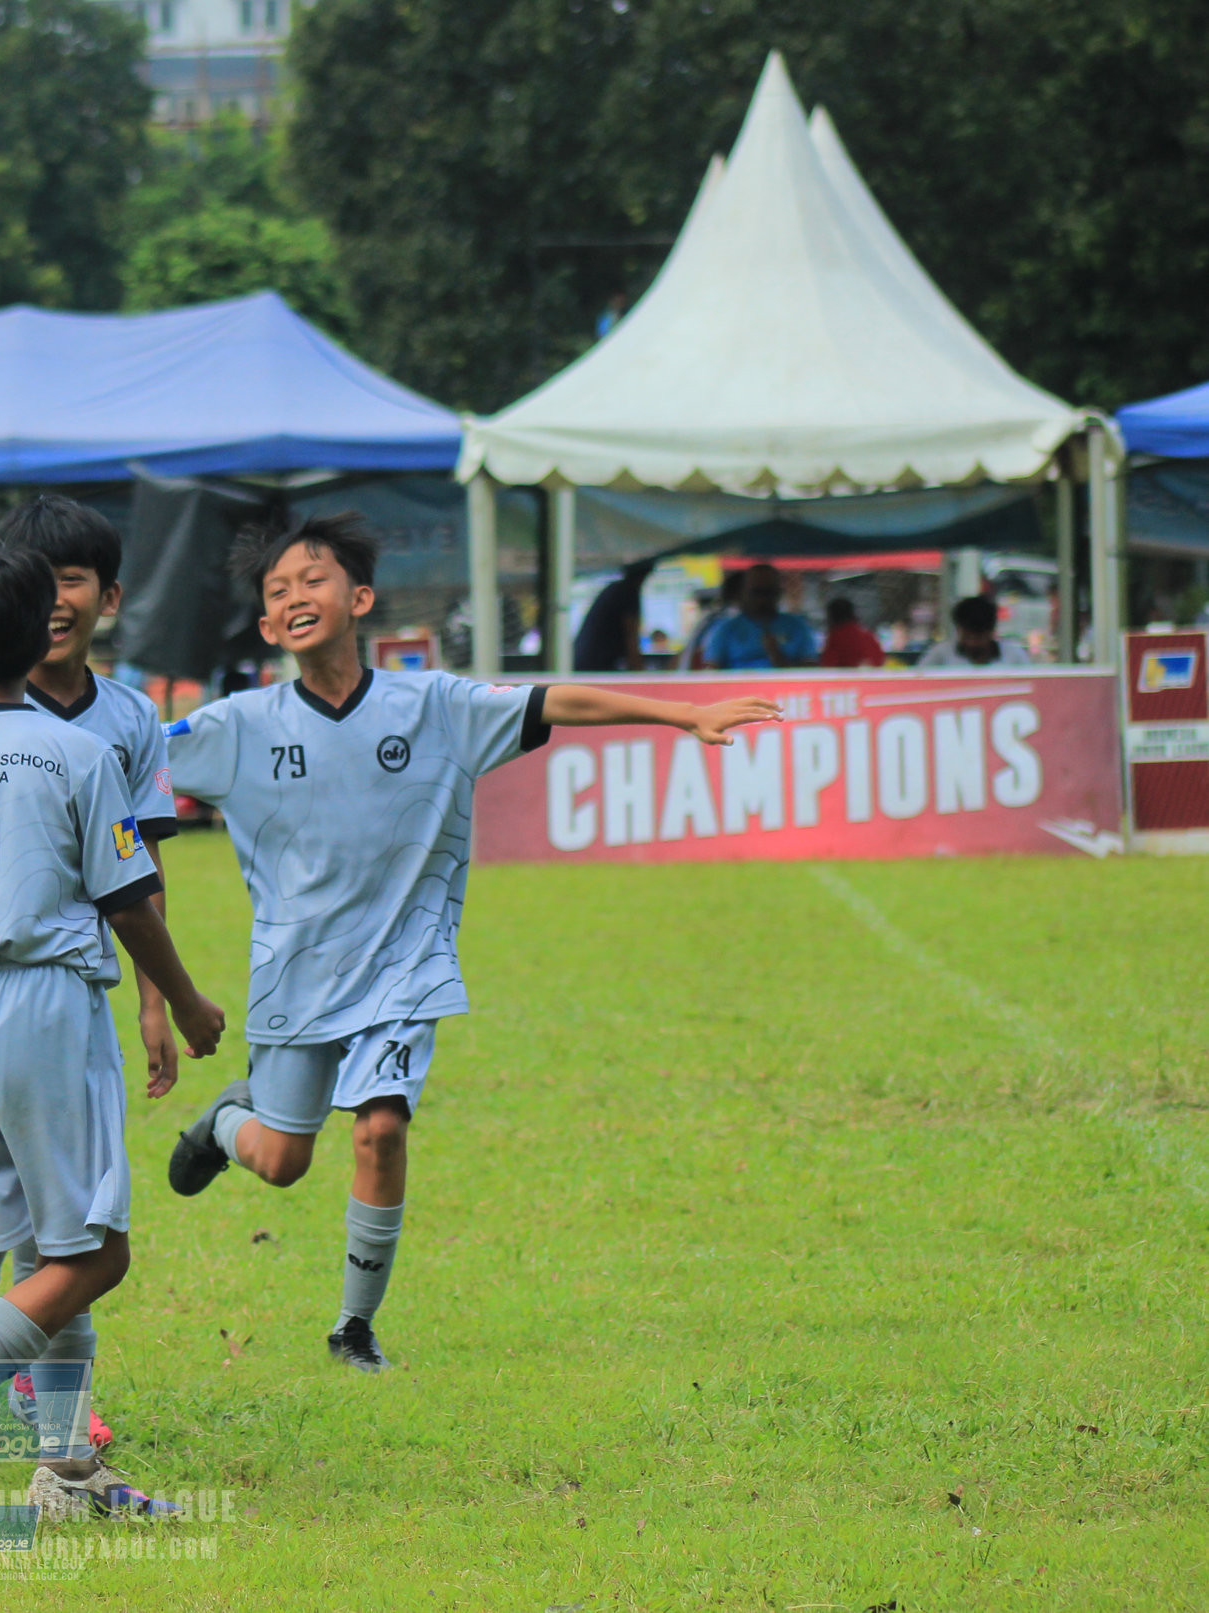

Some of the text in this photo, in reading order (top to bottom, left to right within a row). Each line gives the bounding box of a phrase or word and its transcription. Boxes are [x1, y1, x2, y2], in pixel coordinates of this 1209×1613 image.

[0, 753, 64, 777] SCHOOL
[271, 744, 307, 781] 79
[547, 701, 1043, 852] CHAMPIONS
